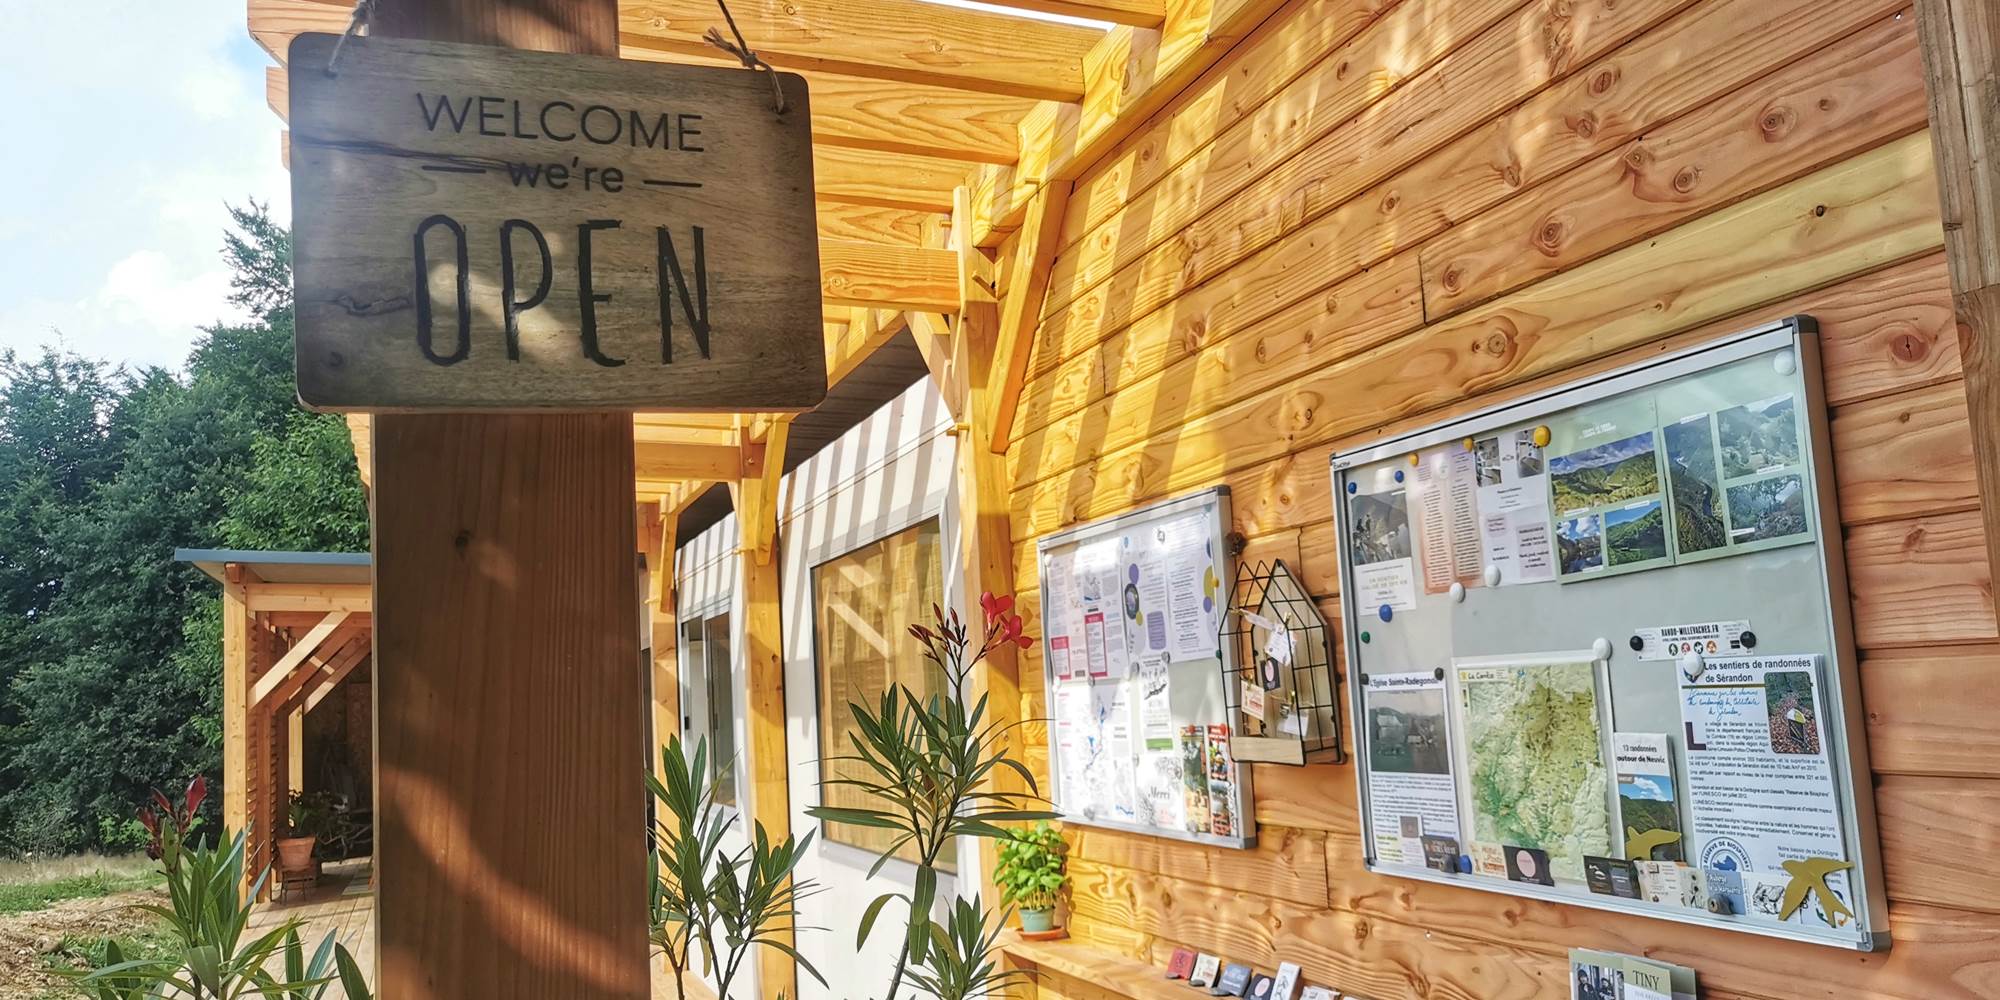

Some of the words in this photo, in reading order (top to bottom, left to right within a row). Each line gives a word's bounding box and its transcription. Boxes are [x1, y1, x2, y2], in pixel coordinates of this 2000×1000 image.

[417, 92, 705, 153] WELCOME
[506, 156, 625, 192] we're
[413, 214, 713, 368] OPEN
[1705, 675, 1715, 683] de
[1716, 673, 1753, 683] Sérandon
[1719, 660, 1750, 670] sentiers
[1752, 659, 1763, 669] de
[1764, 658, 1811, 668] randonnées
[1633, 970, 1659, 991] TINY
